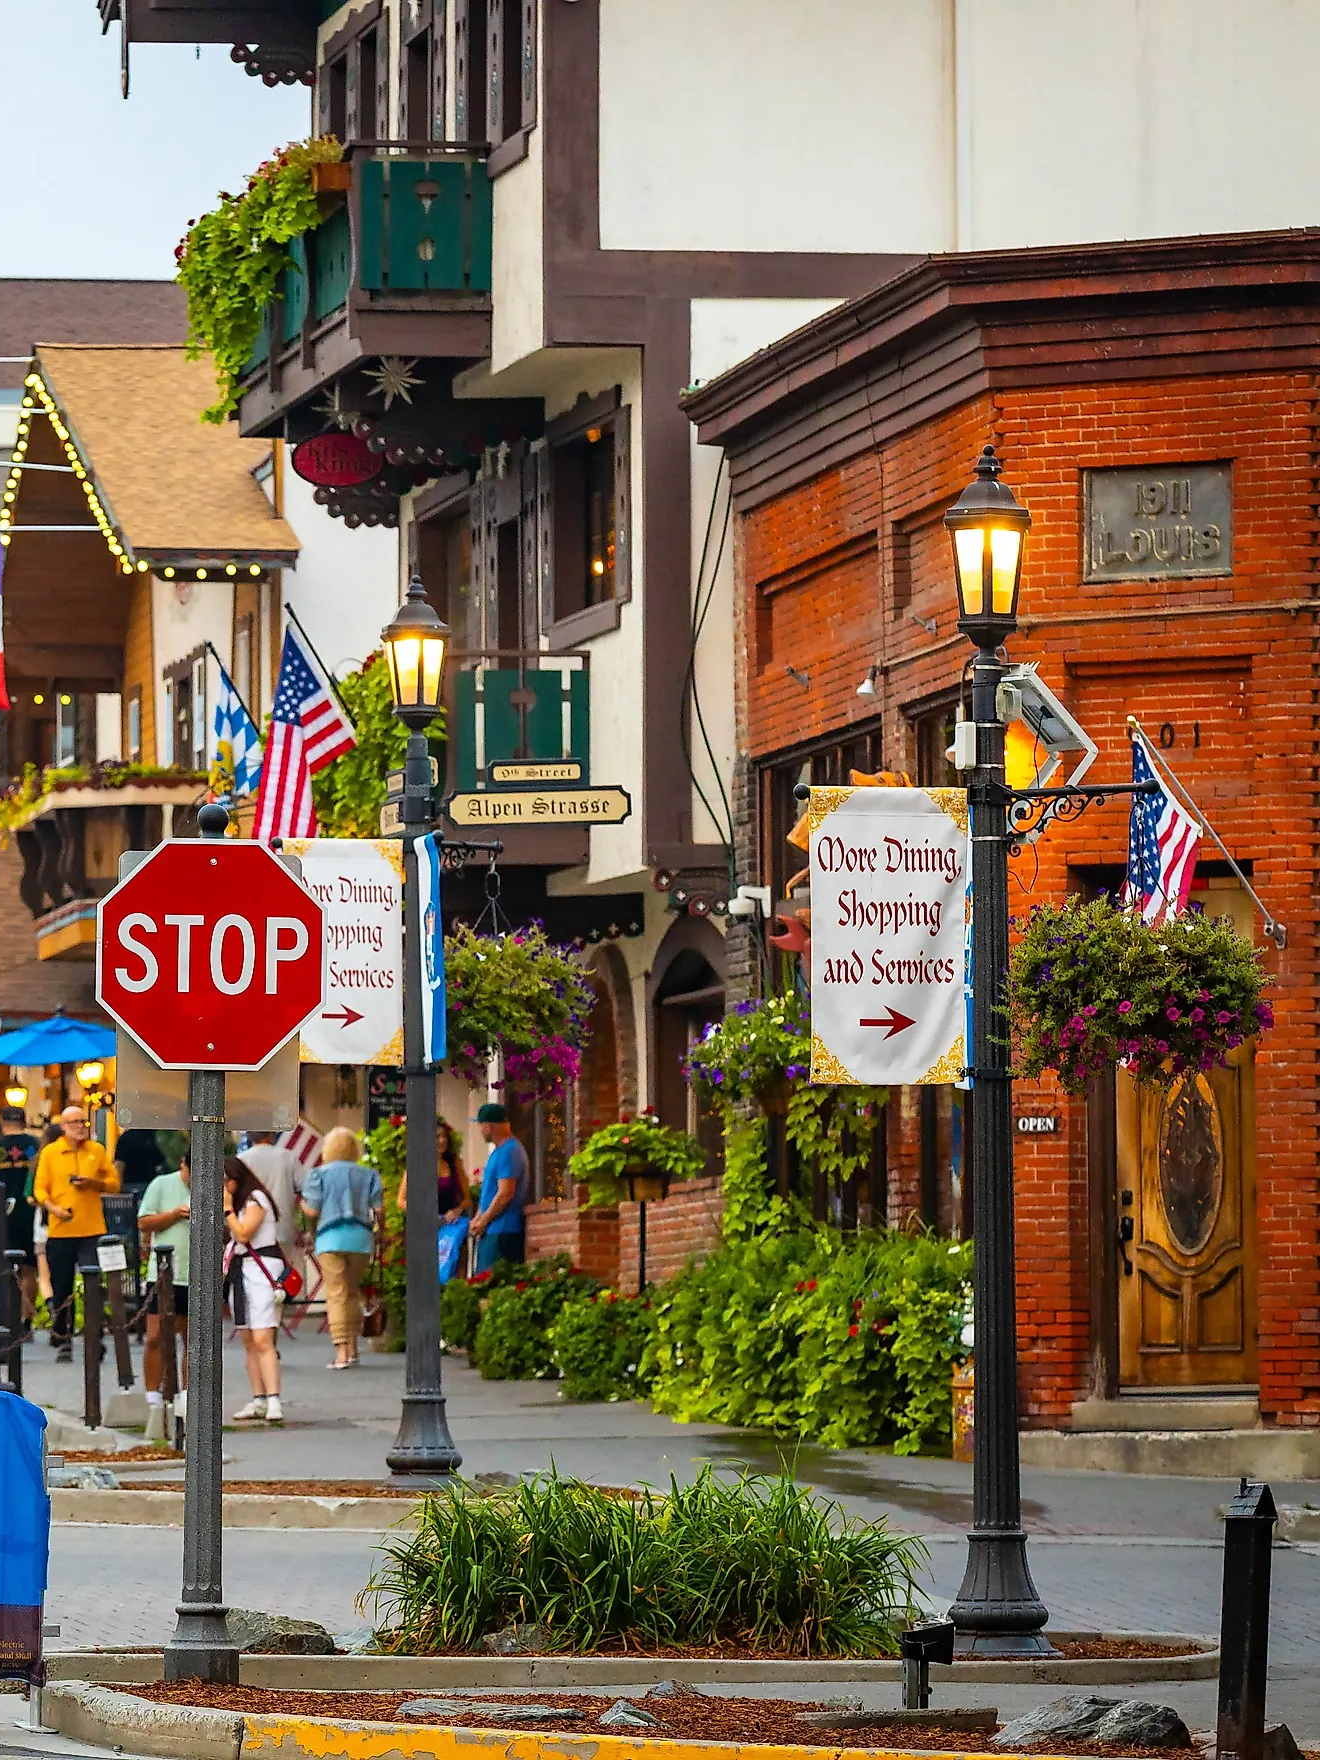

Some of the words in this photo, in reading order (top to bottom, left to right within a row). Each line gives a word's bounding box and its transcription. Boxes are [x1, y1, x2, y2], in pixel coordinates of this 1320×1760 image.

[1134, 479, 1193, 517] 1911
[1098, 523, 1221, 566] LOUIS
[525, 767, 572, 778] Street
[467, 798, 522, 819] Alpen
[531, 796, 610, 816] Strasse
[817, 835, 878, 873] More
[882, 836, 962, 884] Dining,
[837, 889, 943, 937] Shopping
[326, 918, 383, 952] opping
[114, 912, 310, 996] STOP
[823, 949, 864, 985] and
[870, 948, 955, 985] Services
[329, 961, 394, 988] Services
[1018, 1117, 1055, 1131] OPEN
